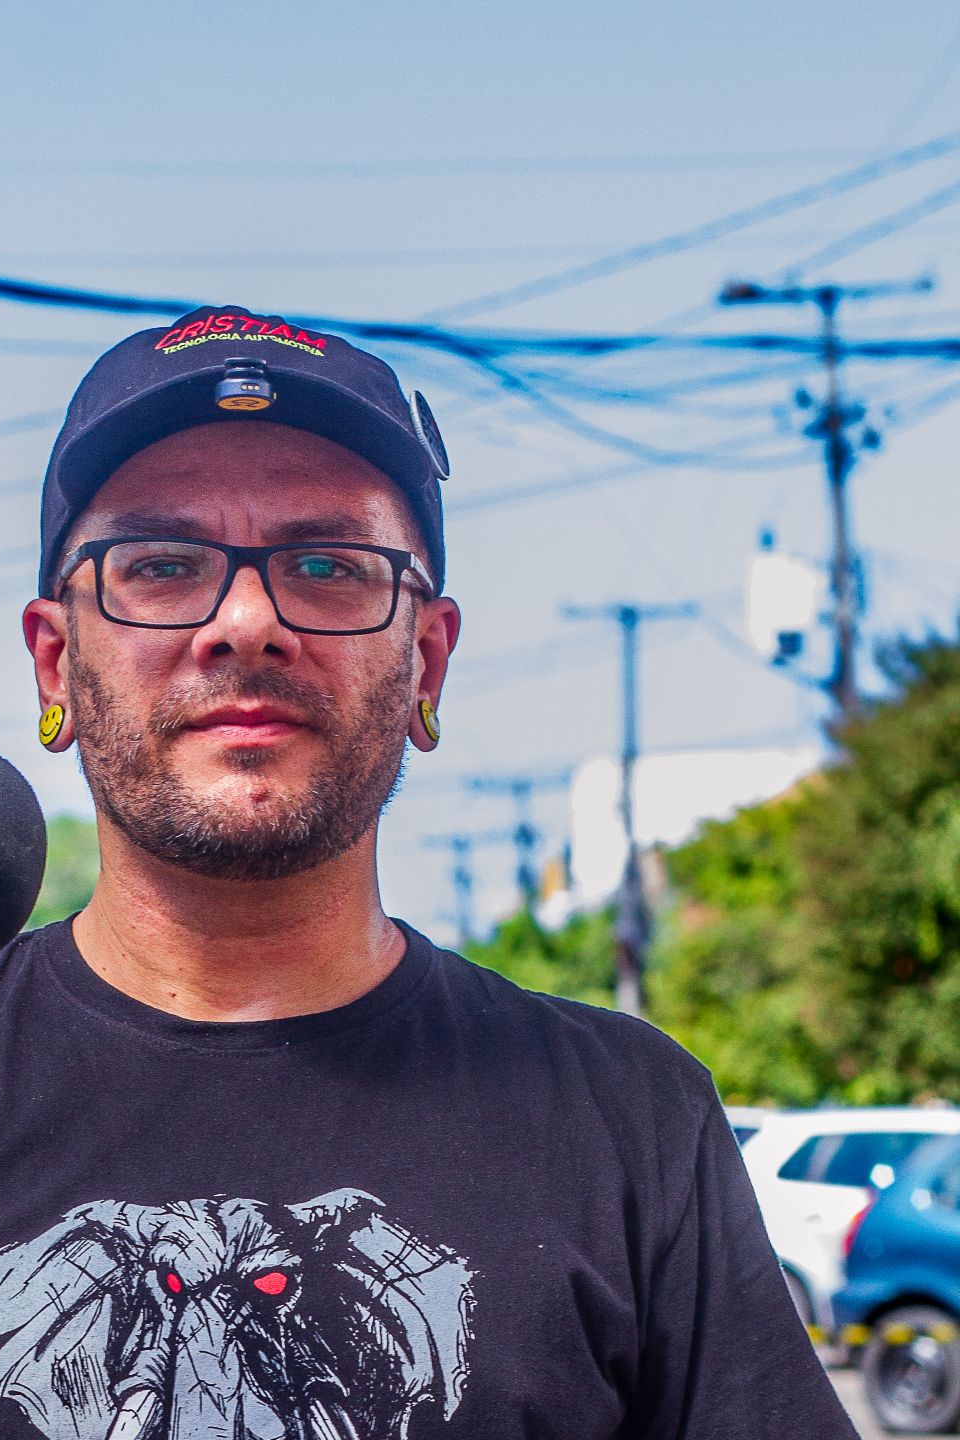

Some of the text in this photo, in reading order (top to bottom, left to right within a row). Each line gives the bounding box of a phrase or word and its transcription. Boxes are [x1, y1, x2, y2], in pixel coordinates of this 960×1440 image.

[155, 314, 327, 350] CRISTIAM
[162, 332, 326, 357] TECNOLOGIA AUTOMOTIVA
